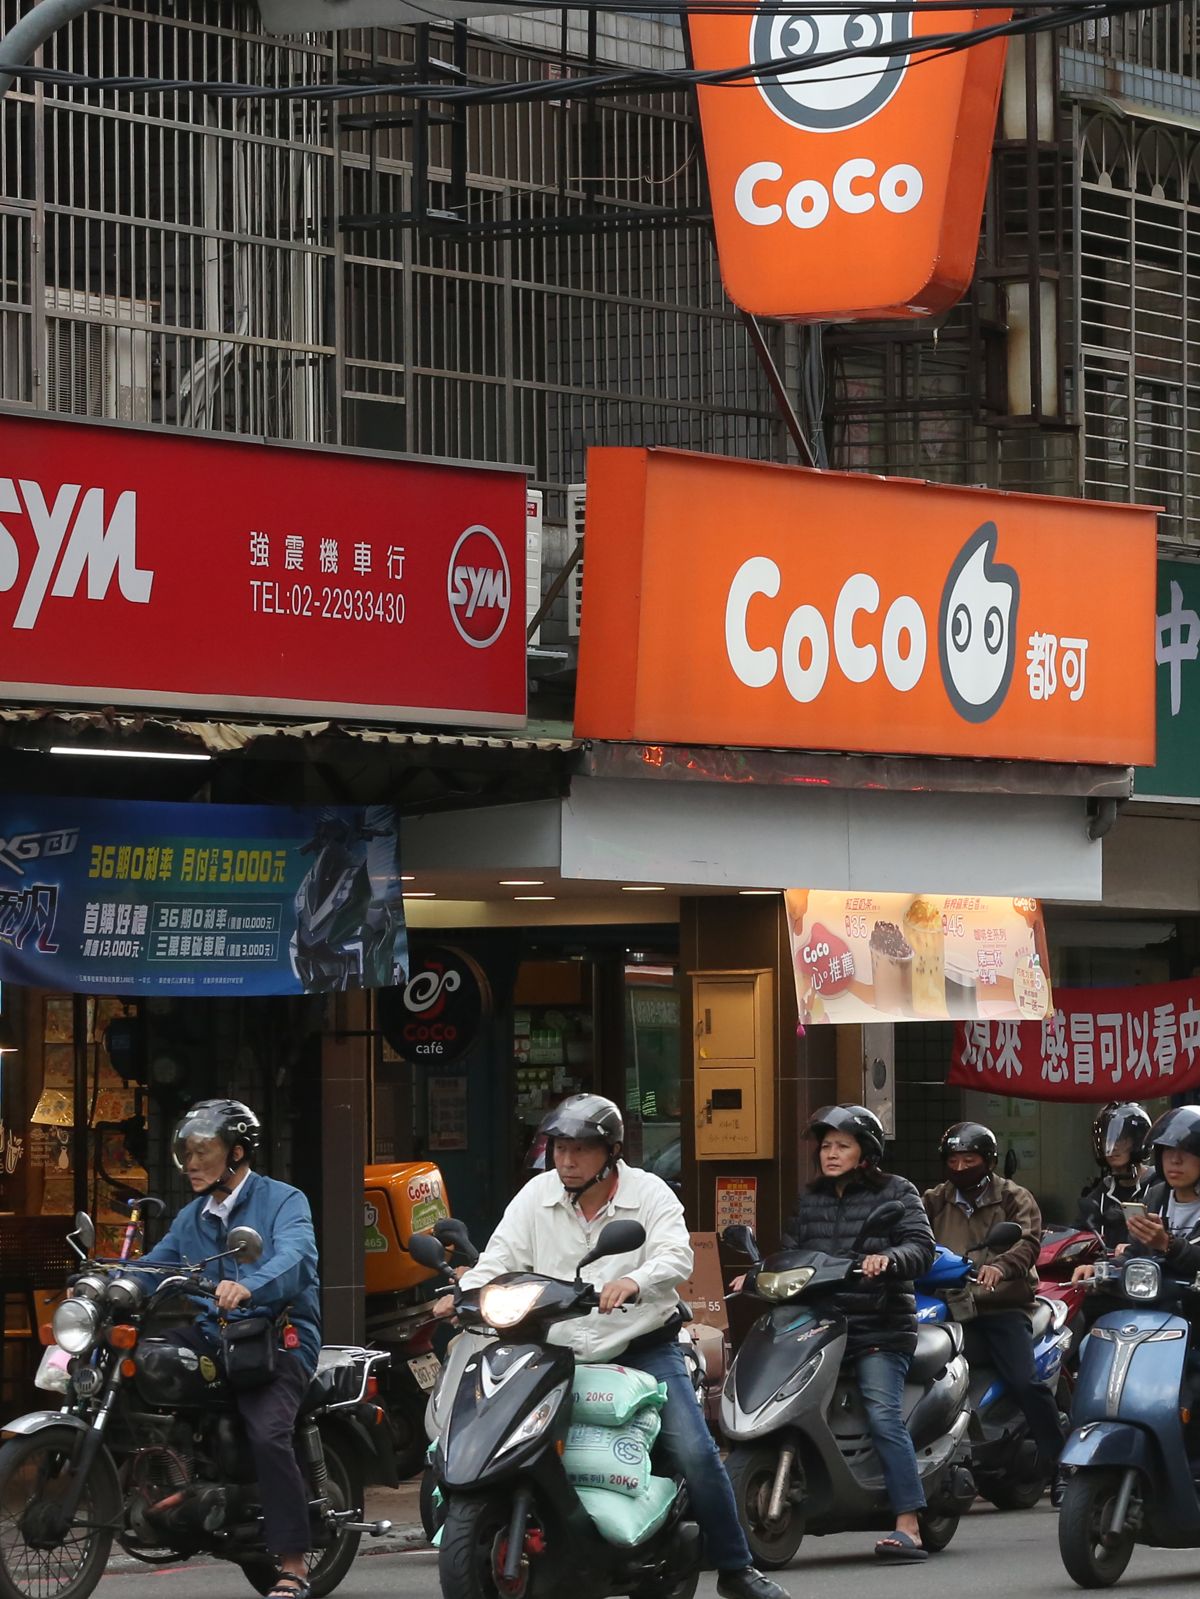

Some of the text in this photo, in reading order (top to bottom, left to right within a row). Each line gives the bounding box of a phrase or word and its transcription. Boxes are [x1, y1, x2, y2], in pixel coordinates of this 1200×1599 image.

[734, 158, 923, 229] CoCo
[250, 532, 405, 580] 強震機車行
[250, 582, 405, 624] TEL:02-22933430
[450, 567, 509, 618] SYM
[725, 556, 927, 703] CoCo
[1026, 631, 1088, 701] 都可
[83, 902, 149, 936] 首購好禮
[803, 942, 829, 963] CoCo
[416, 1041, 444, 1055] café
[586, 1391, 614, 1402] 20KG
